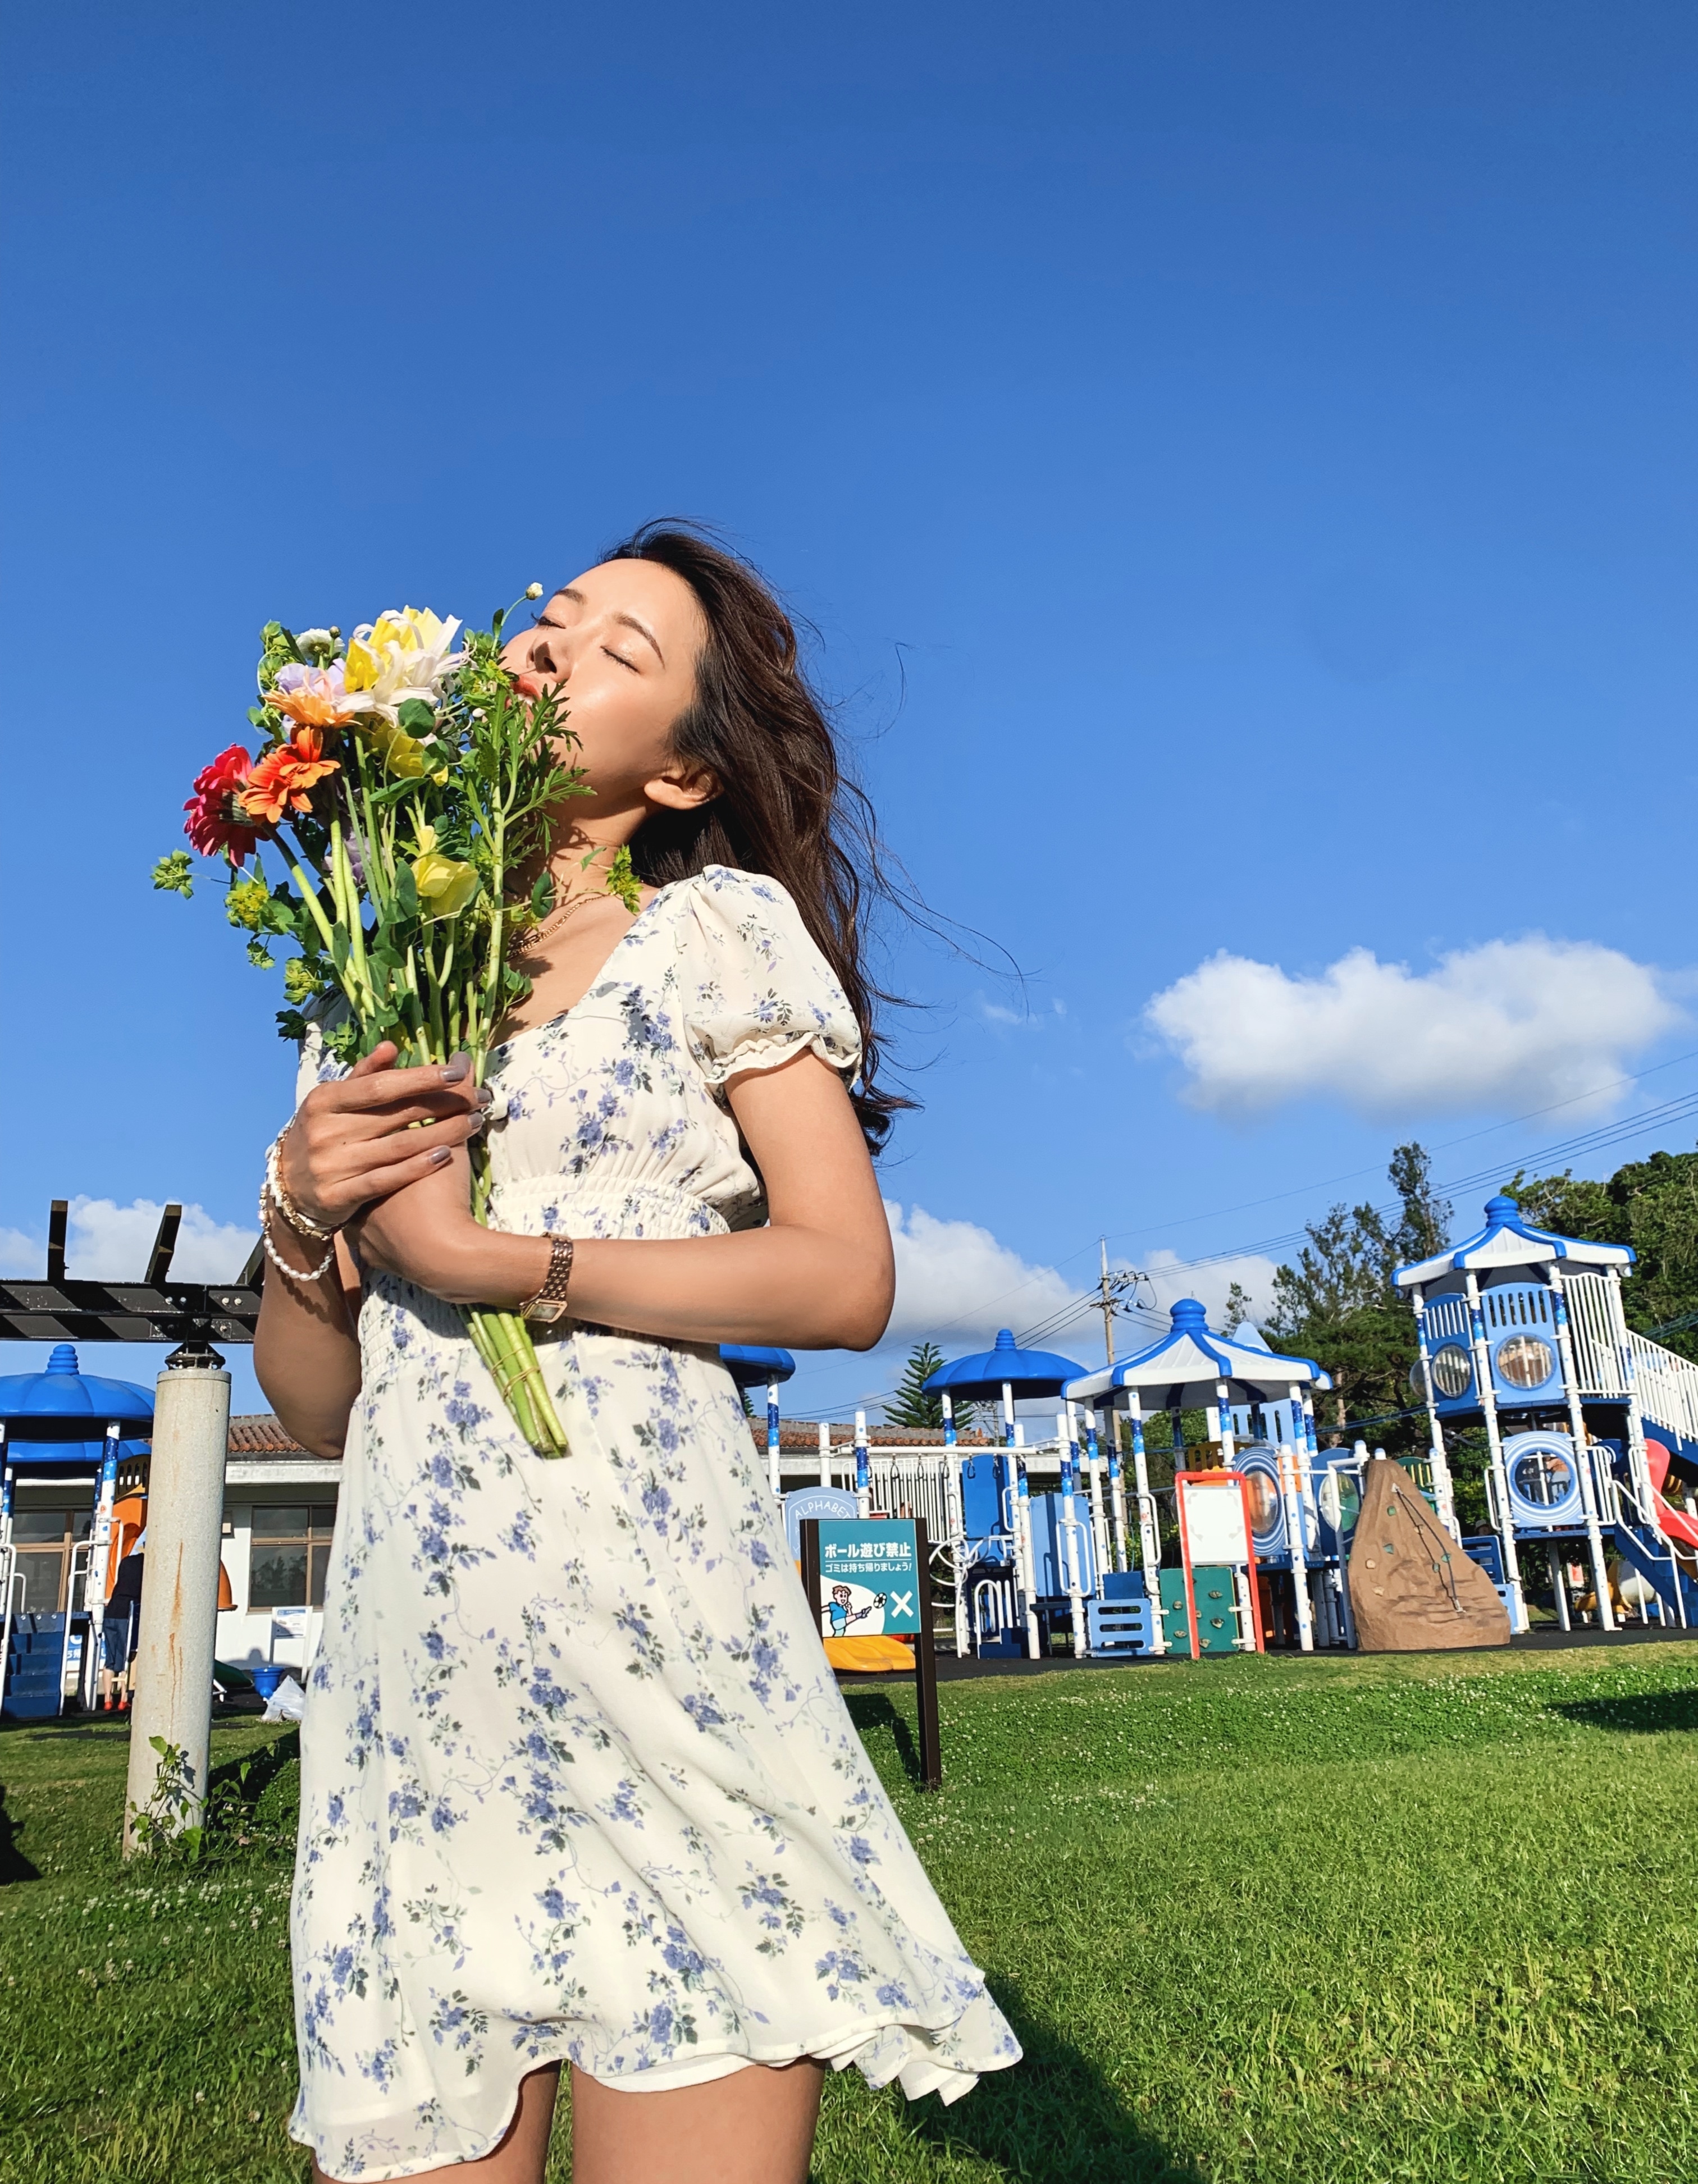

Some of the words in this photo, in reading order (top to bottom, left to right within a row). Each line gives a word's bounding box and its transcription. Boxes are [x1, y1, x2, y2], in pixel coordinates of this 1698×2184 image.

[795, 1500, 851, 1519] ALPHABET
[825, 1542, 912, 1558] ボール遊び禁止
